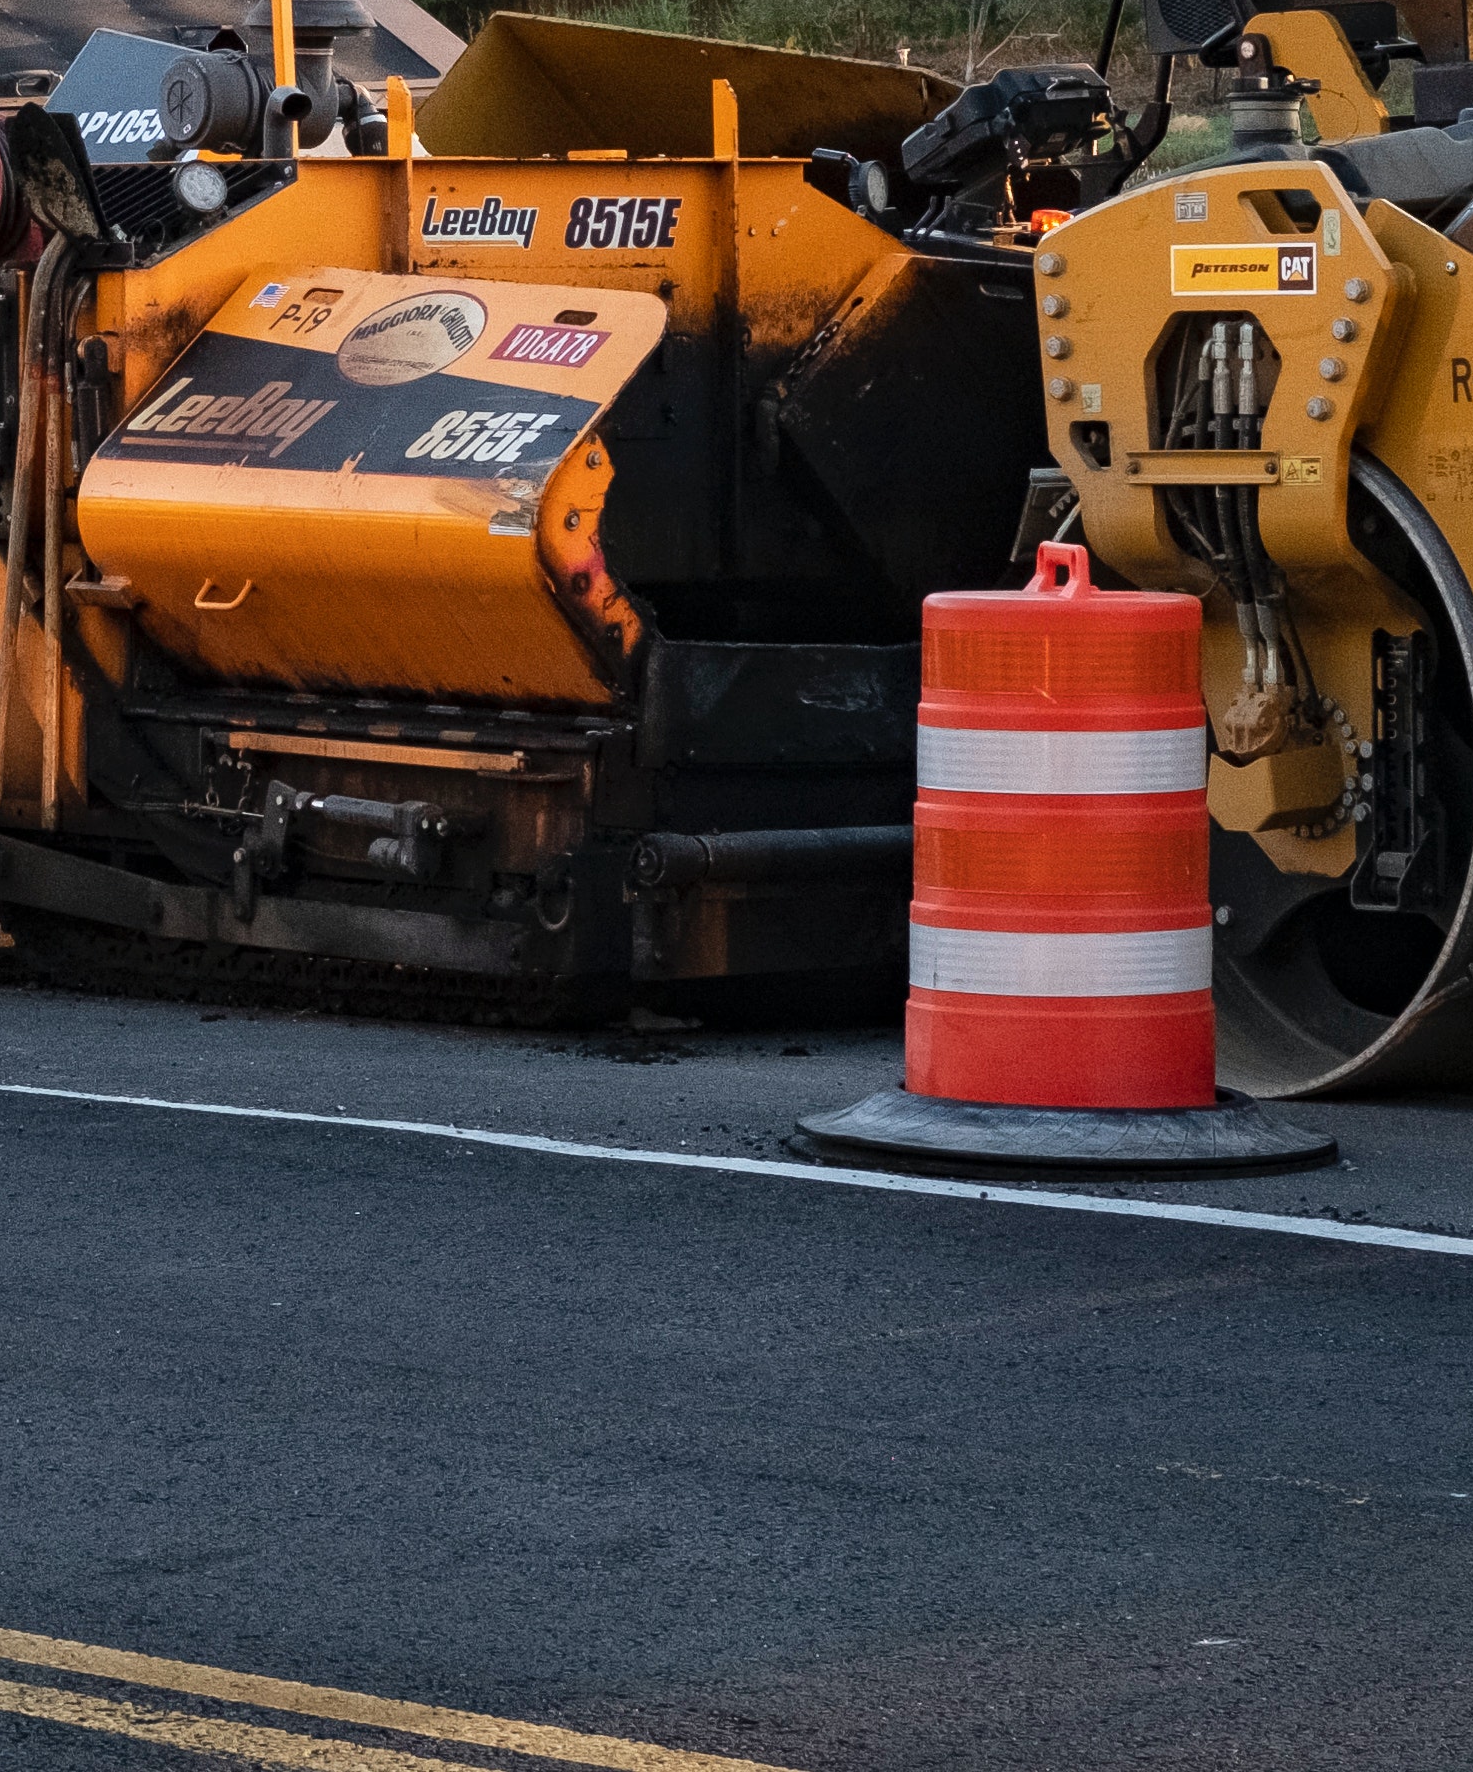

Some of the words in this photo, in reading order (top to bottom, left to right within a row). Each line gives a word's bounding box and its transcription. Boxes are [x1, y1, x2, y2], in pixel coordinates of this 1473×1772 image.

[78, 109, 165, 144] P1055
[422, 197, 538, 249] LeeBoy
[564, 197, 683, 249] 8515E
[1191, 263, 1270, 278] PETERSON
[1280, 256, 1312, 281] CAT
[268, 304, 333, 334] P-19
[350, 304, 442, 342] MAGGIORA
[439, 307, 475, 352] GHILOTTI
[502, 327, 599, 364] VD6A78
[127, 377, 340, 458] LeeBoy
[404, 410, 560, 463] 8515E
